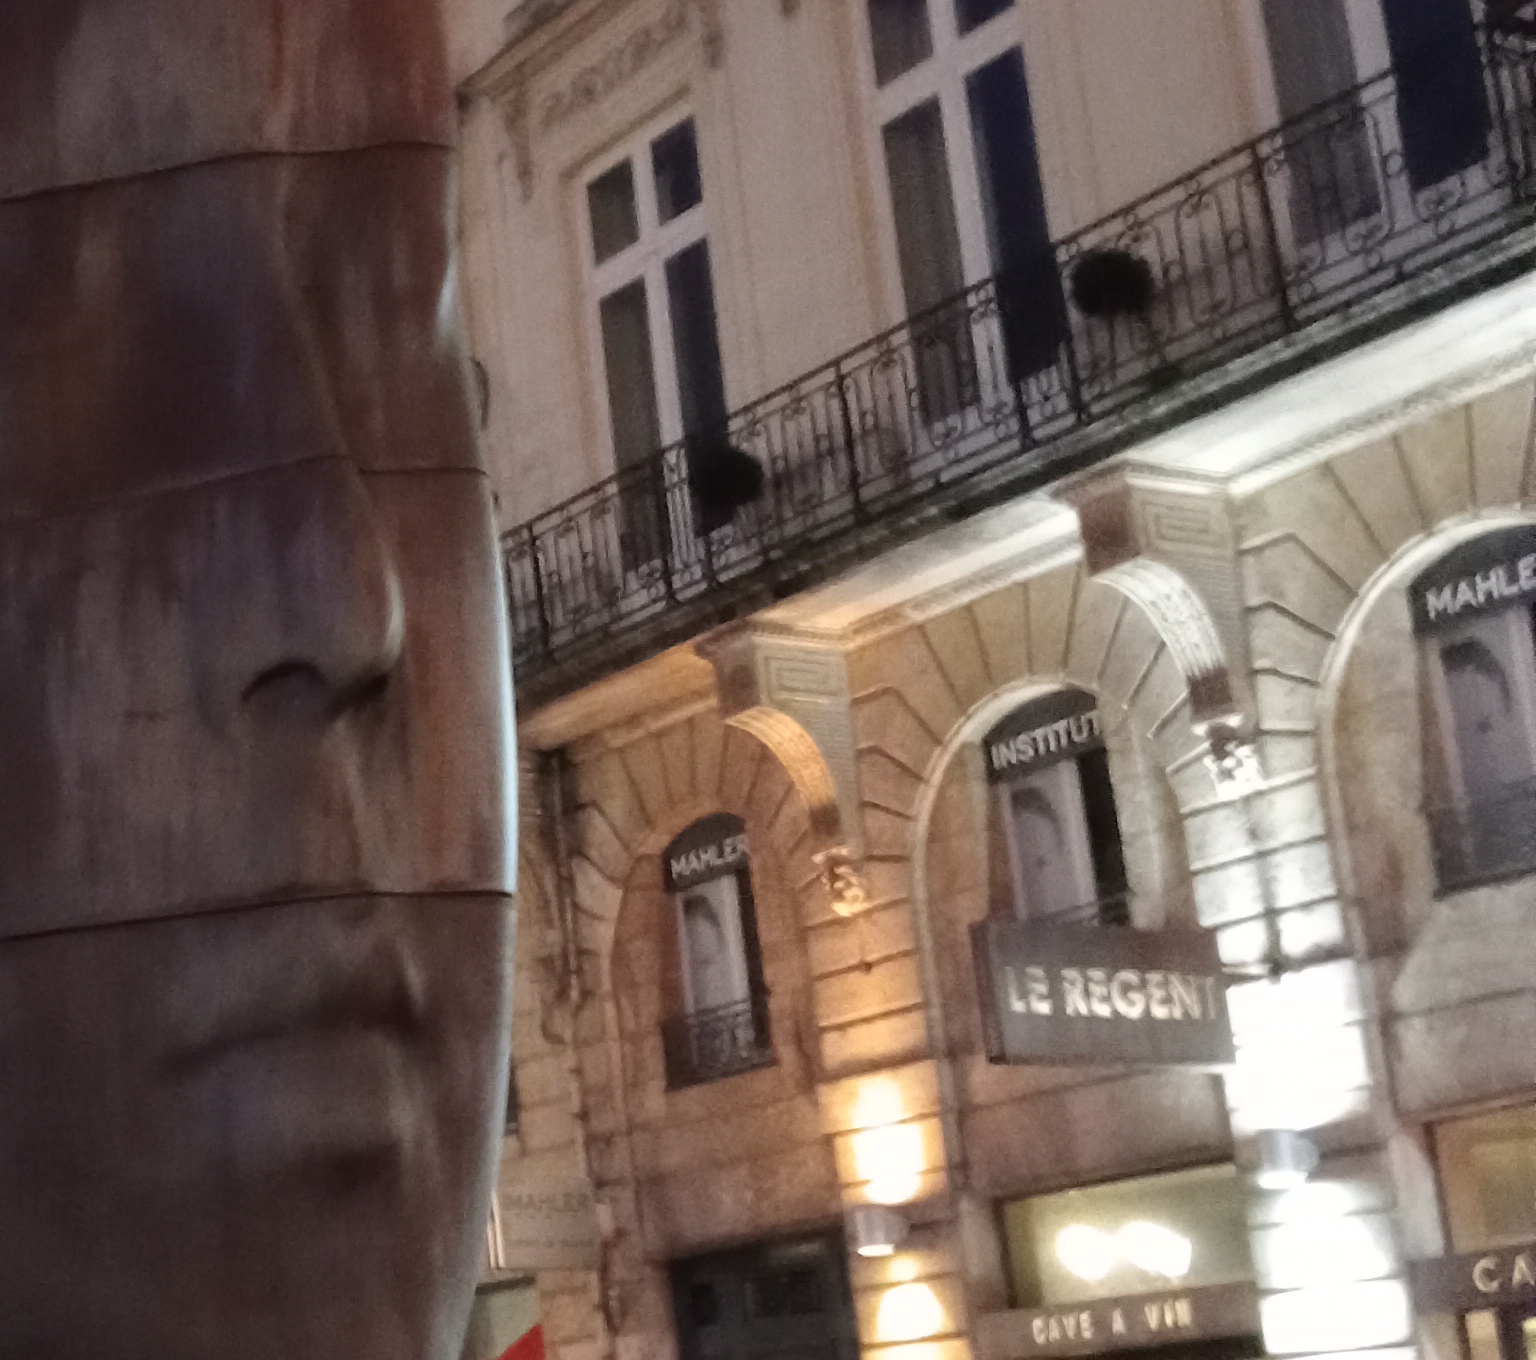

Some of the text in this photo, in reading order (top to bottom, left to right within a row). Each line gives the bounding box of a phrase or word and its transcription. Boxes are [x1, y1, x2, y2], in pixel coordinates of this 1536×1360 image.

[990, 709, 1101, 770] INSTITUT
[1005, 965, 1053, 1016] LE
[1032, 1309, 1093, 1345] CAVE
[1144, 1297, 1192, 1333] VIN
